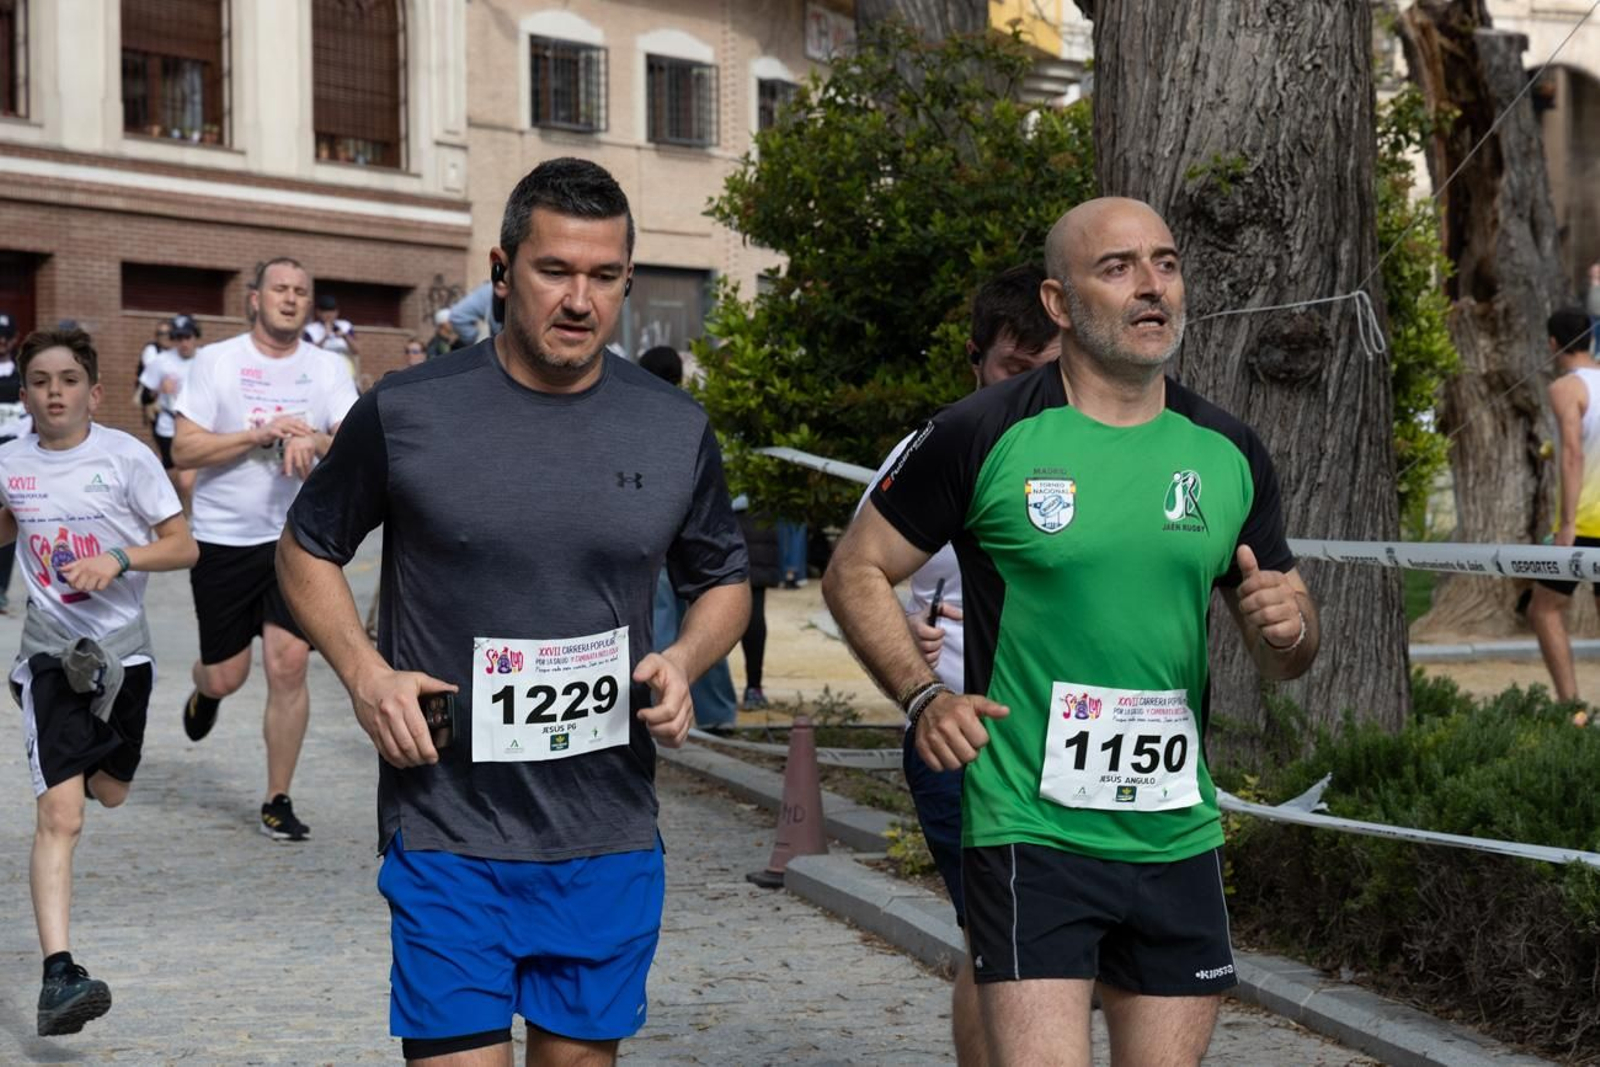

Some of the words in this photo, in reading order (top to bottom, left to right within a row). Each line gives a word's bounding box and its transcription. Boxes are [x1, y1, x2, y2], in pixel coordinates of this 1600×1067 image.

[1033, 467, 1067, 475] MADRID
[1182, 524, 1205, 532] RUGBY
[1511, 560, 1560, 574] DEPORTES
[539, 646, 561, 657] XXVII
[562, 643, 590, 655] CARRERA
[492, 675, 619, 725] 1229
[541, 725, 565, 735] JESUS
[567, 723, 577, 731] PG
[1065, 730, 1188, 774] 1150
[1100, 776, 1122, 784] JESUS
[1124, 776, 1155, 785] ANGULO
